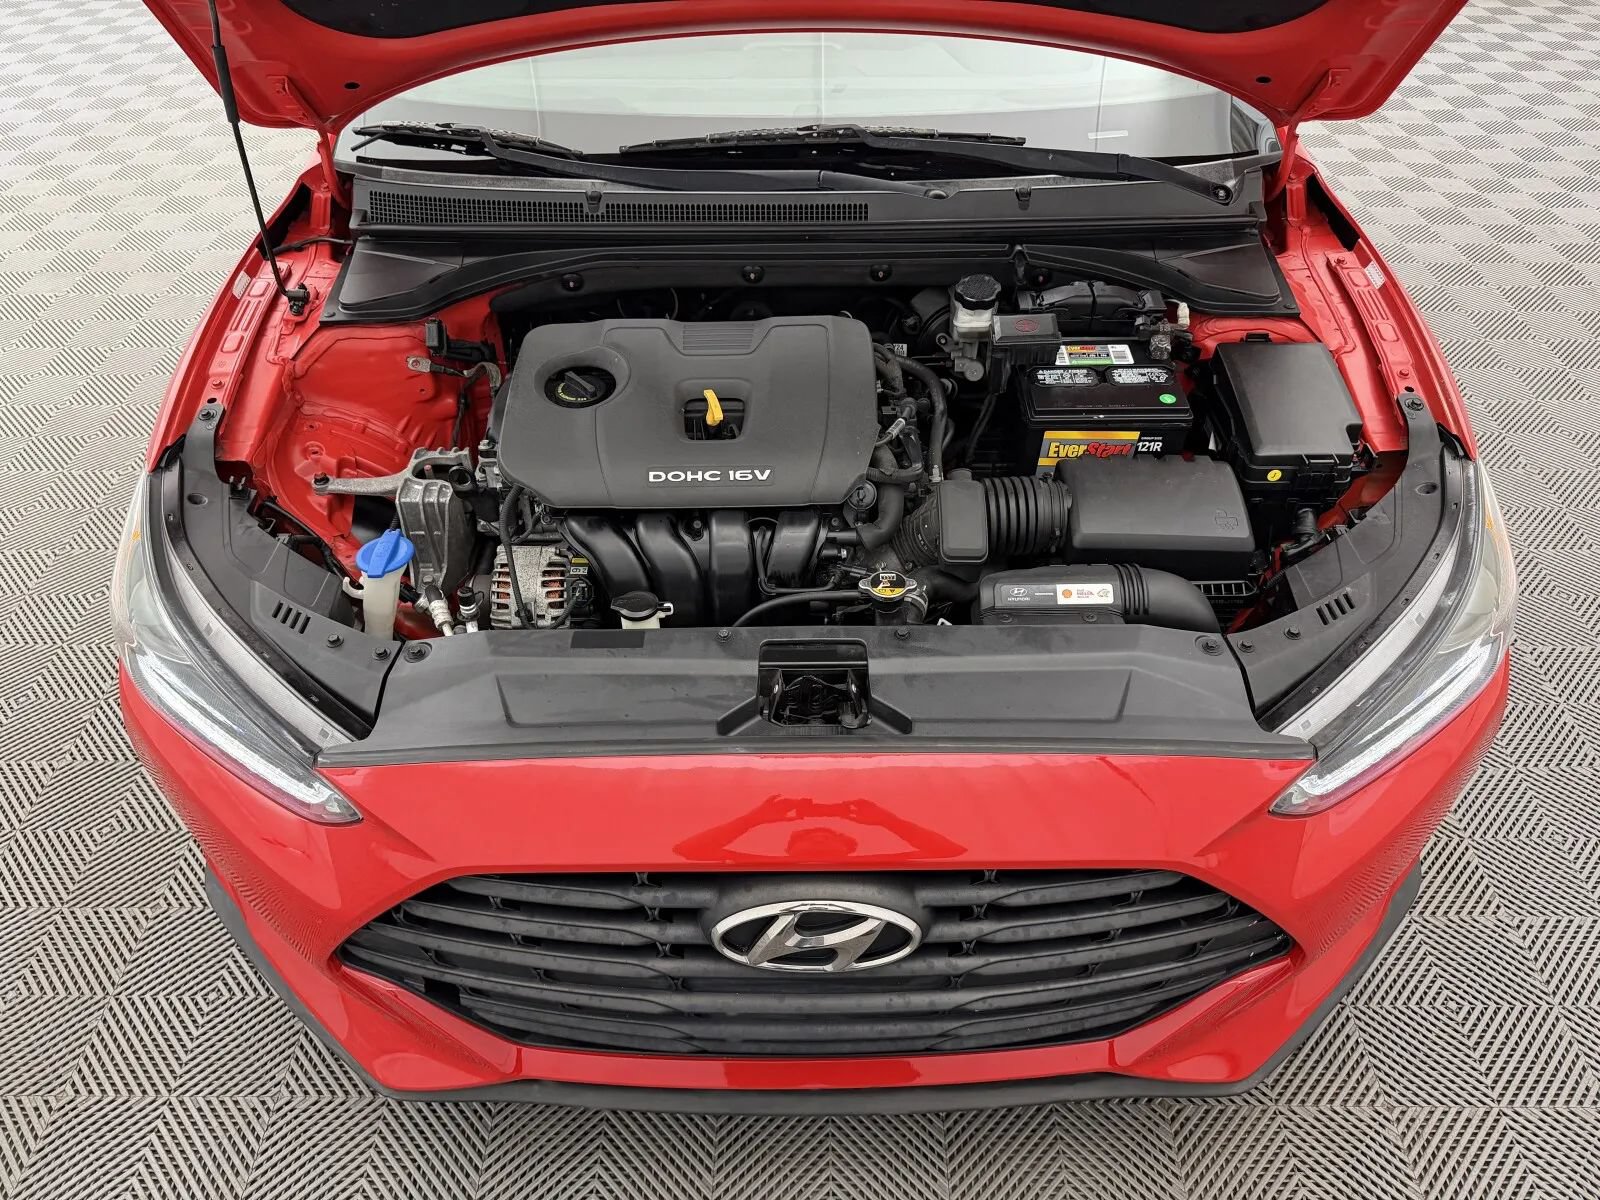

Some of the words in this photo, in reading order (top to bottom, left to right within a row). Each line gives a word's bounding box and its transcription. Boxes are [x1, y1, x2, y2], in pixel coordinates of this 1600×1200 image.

[1048, 441, 1132, 458] EverStart
[1137, 441, 1163, 452] 121R
[648, 470, 722, 482] DOHC
[728, 469, 771, 481] 16V
